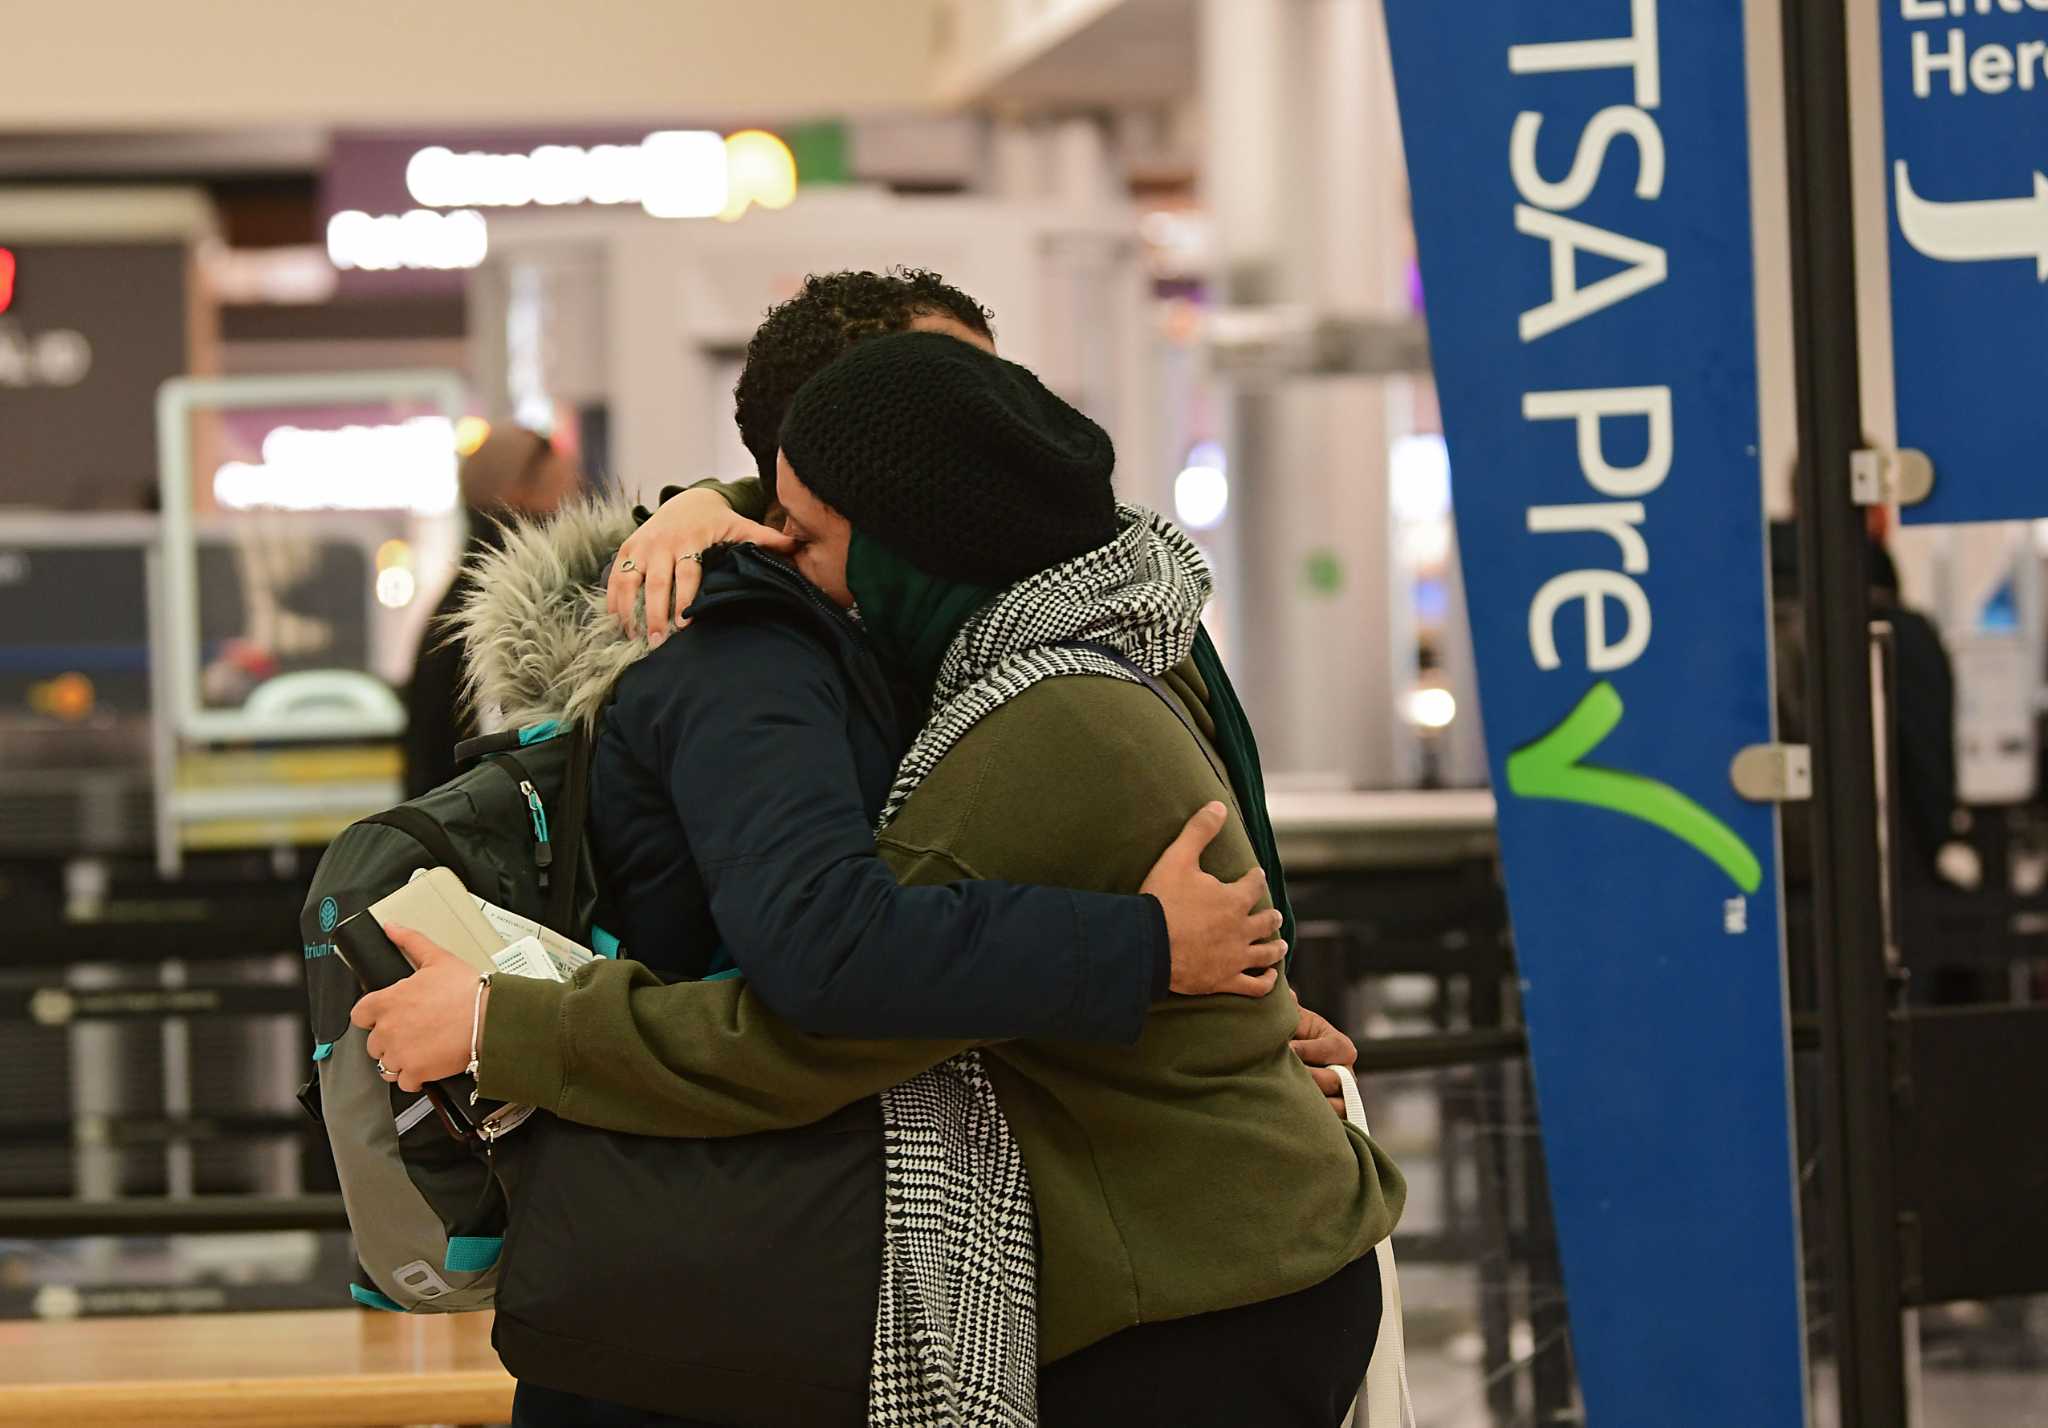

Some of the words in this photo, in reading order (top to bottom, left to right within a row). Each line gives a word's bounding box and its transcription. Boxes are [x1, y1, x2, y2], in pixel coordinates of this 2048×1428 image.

[1508, 0, 1668, 341] TSA
[1911, 27, 2048, 98] Her
[1522, 385, 1673, 671] Pre
